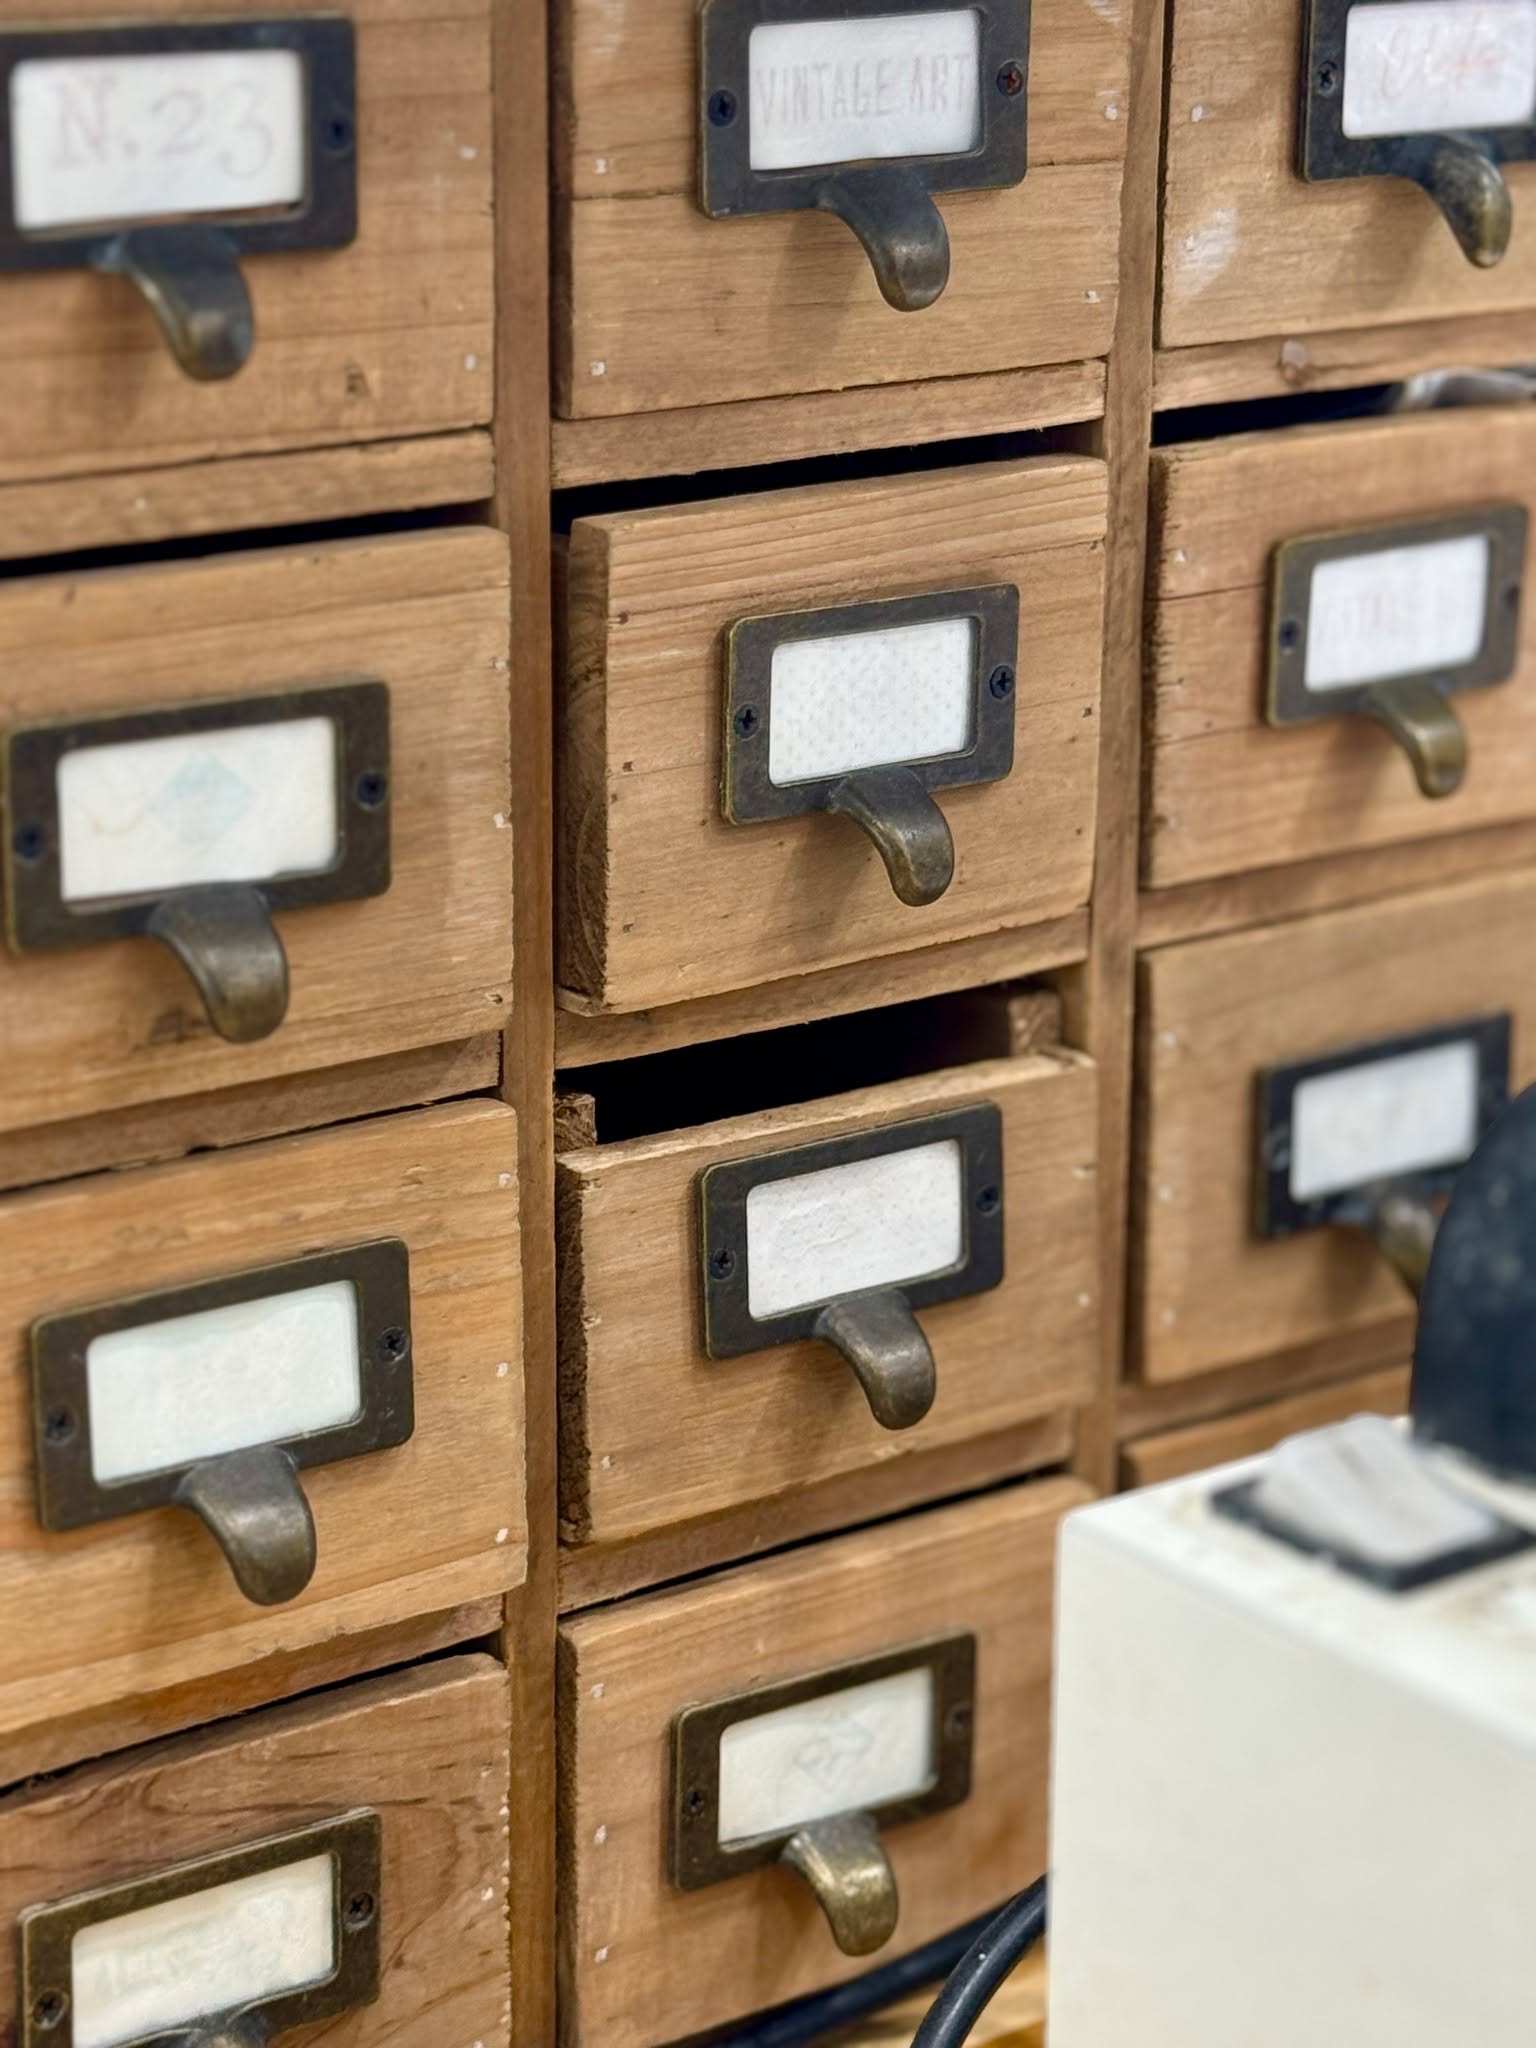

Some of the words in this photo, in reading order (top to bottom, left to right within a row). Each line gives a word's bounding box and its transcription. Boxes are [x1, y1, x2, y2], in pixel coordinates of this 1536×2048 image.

[51, 73, 276, 178] N.23
[756, 60, 897, 129] VINTAGE
[909, 53, 974, 114] ART
